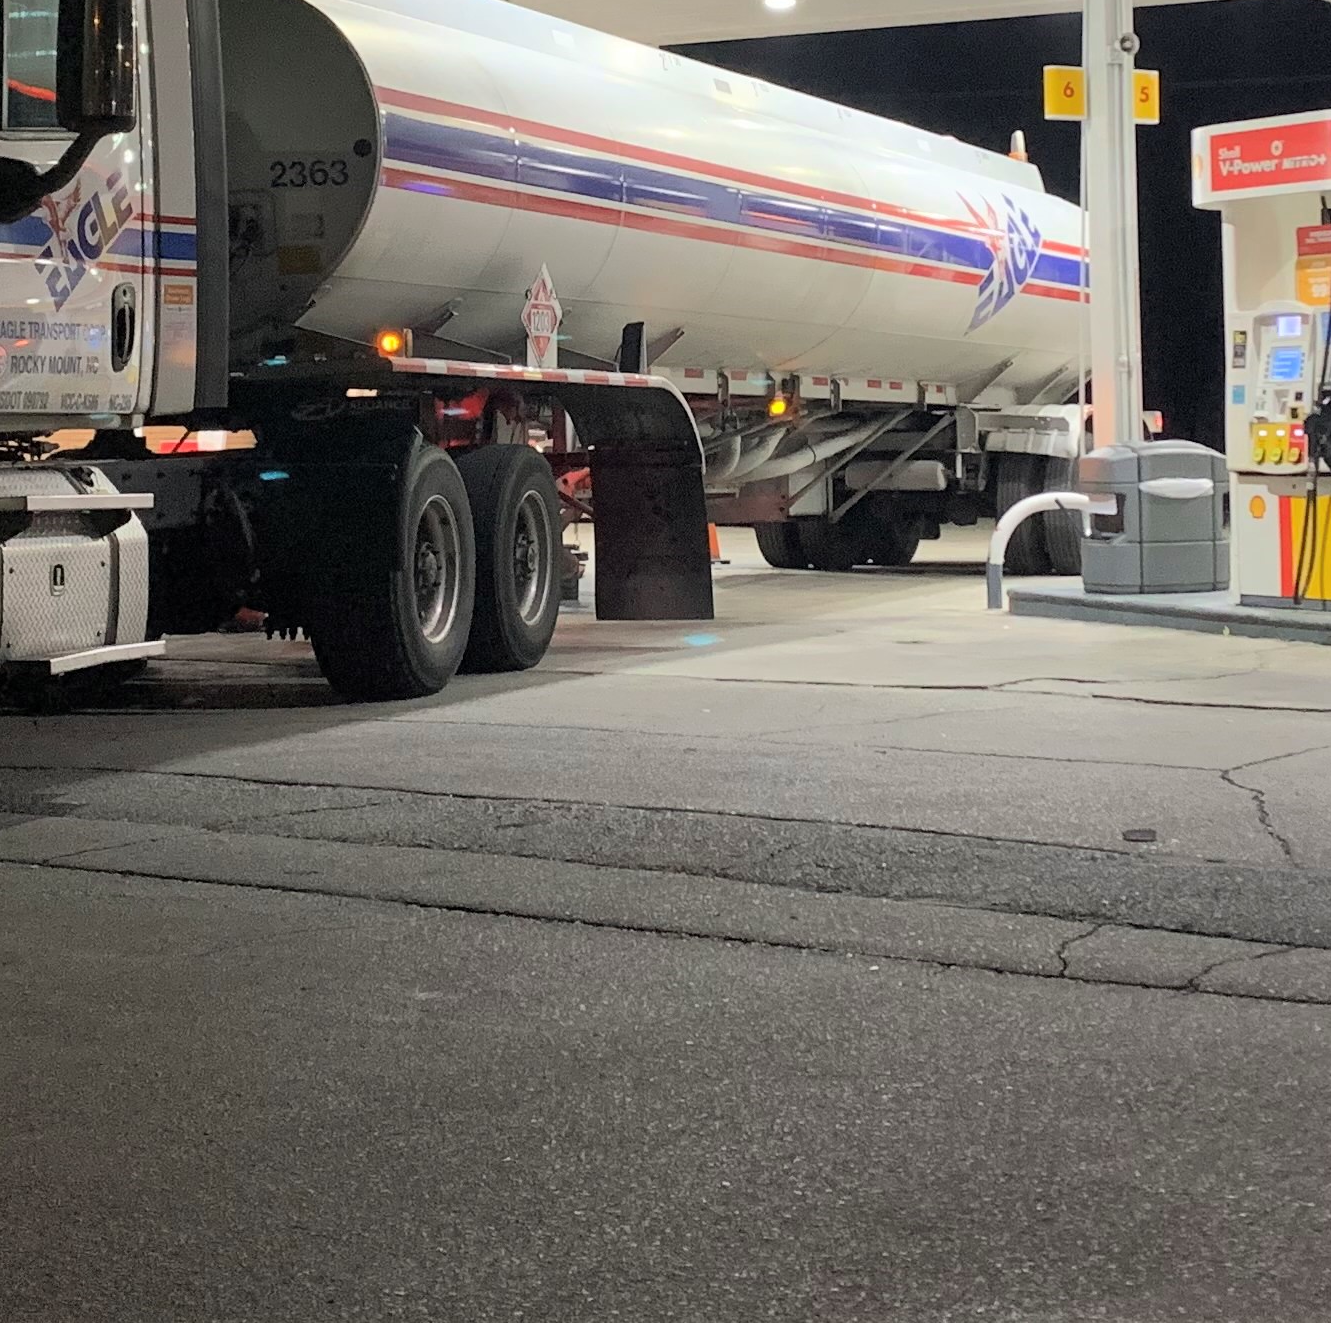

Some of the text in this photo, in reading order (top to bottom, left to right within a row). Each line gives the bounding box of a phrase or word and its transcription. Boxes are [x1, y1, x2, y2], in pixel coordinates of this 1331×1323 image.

[1063, 81, 1075, 99] 6
[1139, 86, 1150, 103] 5
[1219, 146, 1241, 160] Shell
[269, 160, 349, 188] 2363
[1220, 153, 1327, 177] V-Power NITRO+
[34, 171, 134, 313] EAGLE
[28, 321, 81, 341] TRANSPORT
[532, 310, 550, 332] 1203
[10, 355, 46, 374] ROCKY
[49, 356, 84, 376] MOUNT,
